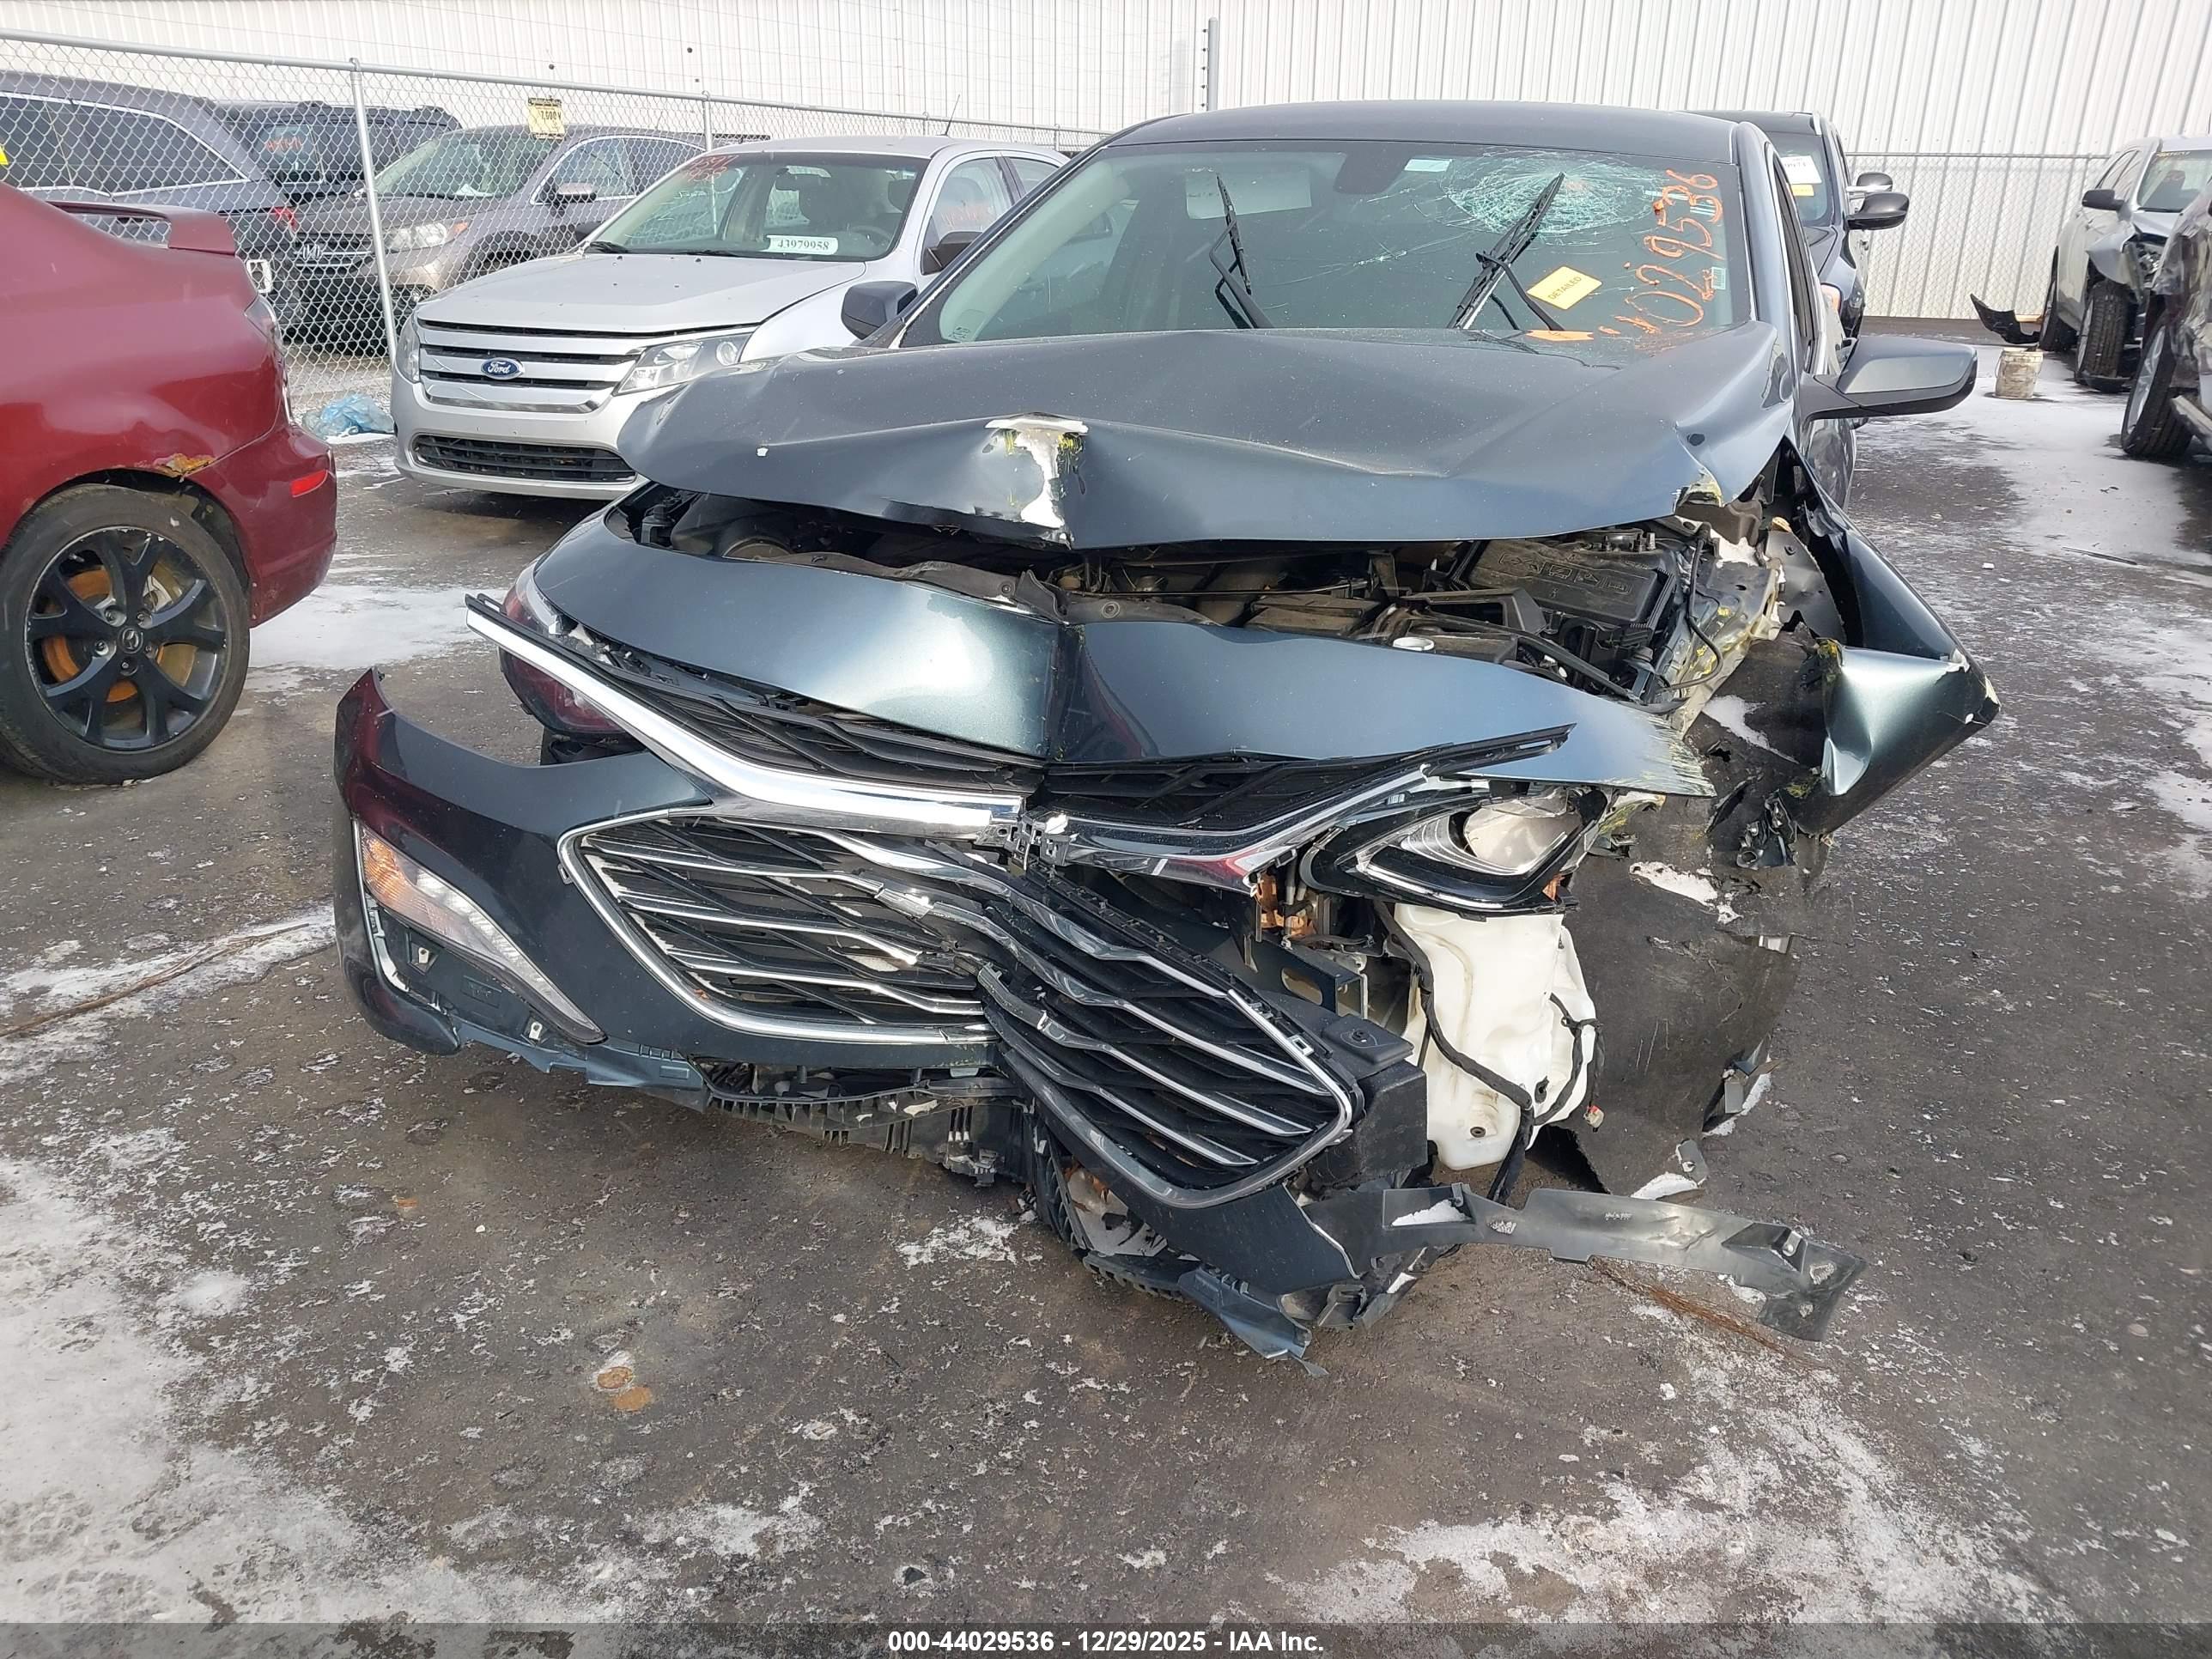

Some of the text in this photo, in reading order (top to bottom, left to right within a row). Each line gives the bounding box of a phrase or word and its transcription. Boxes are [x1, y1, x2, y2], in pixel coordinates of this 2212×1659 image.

[1613, 169, 1725, 335] 029536
[1547, 276, 1582, 300] DETAILED
[487, 361, 512, 374] Ford
